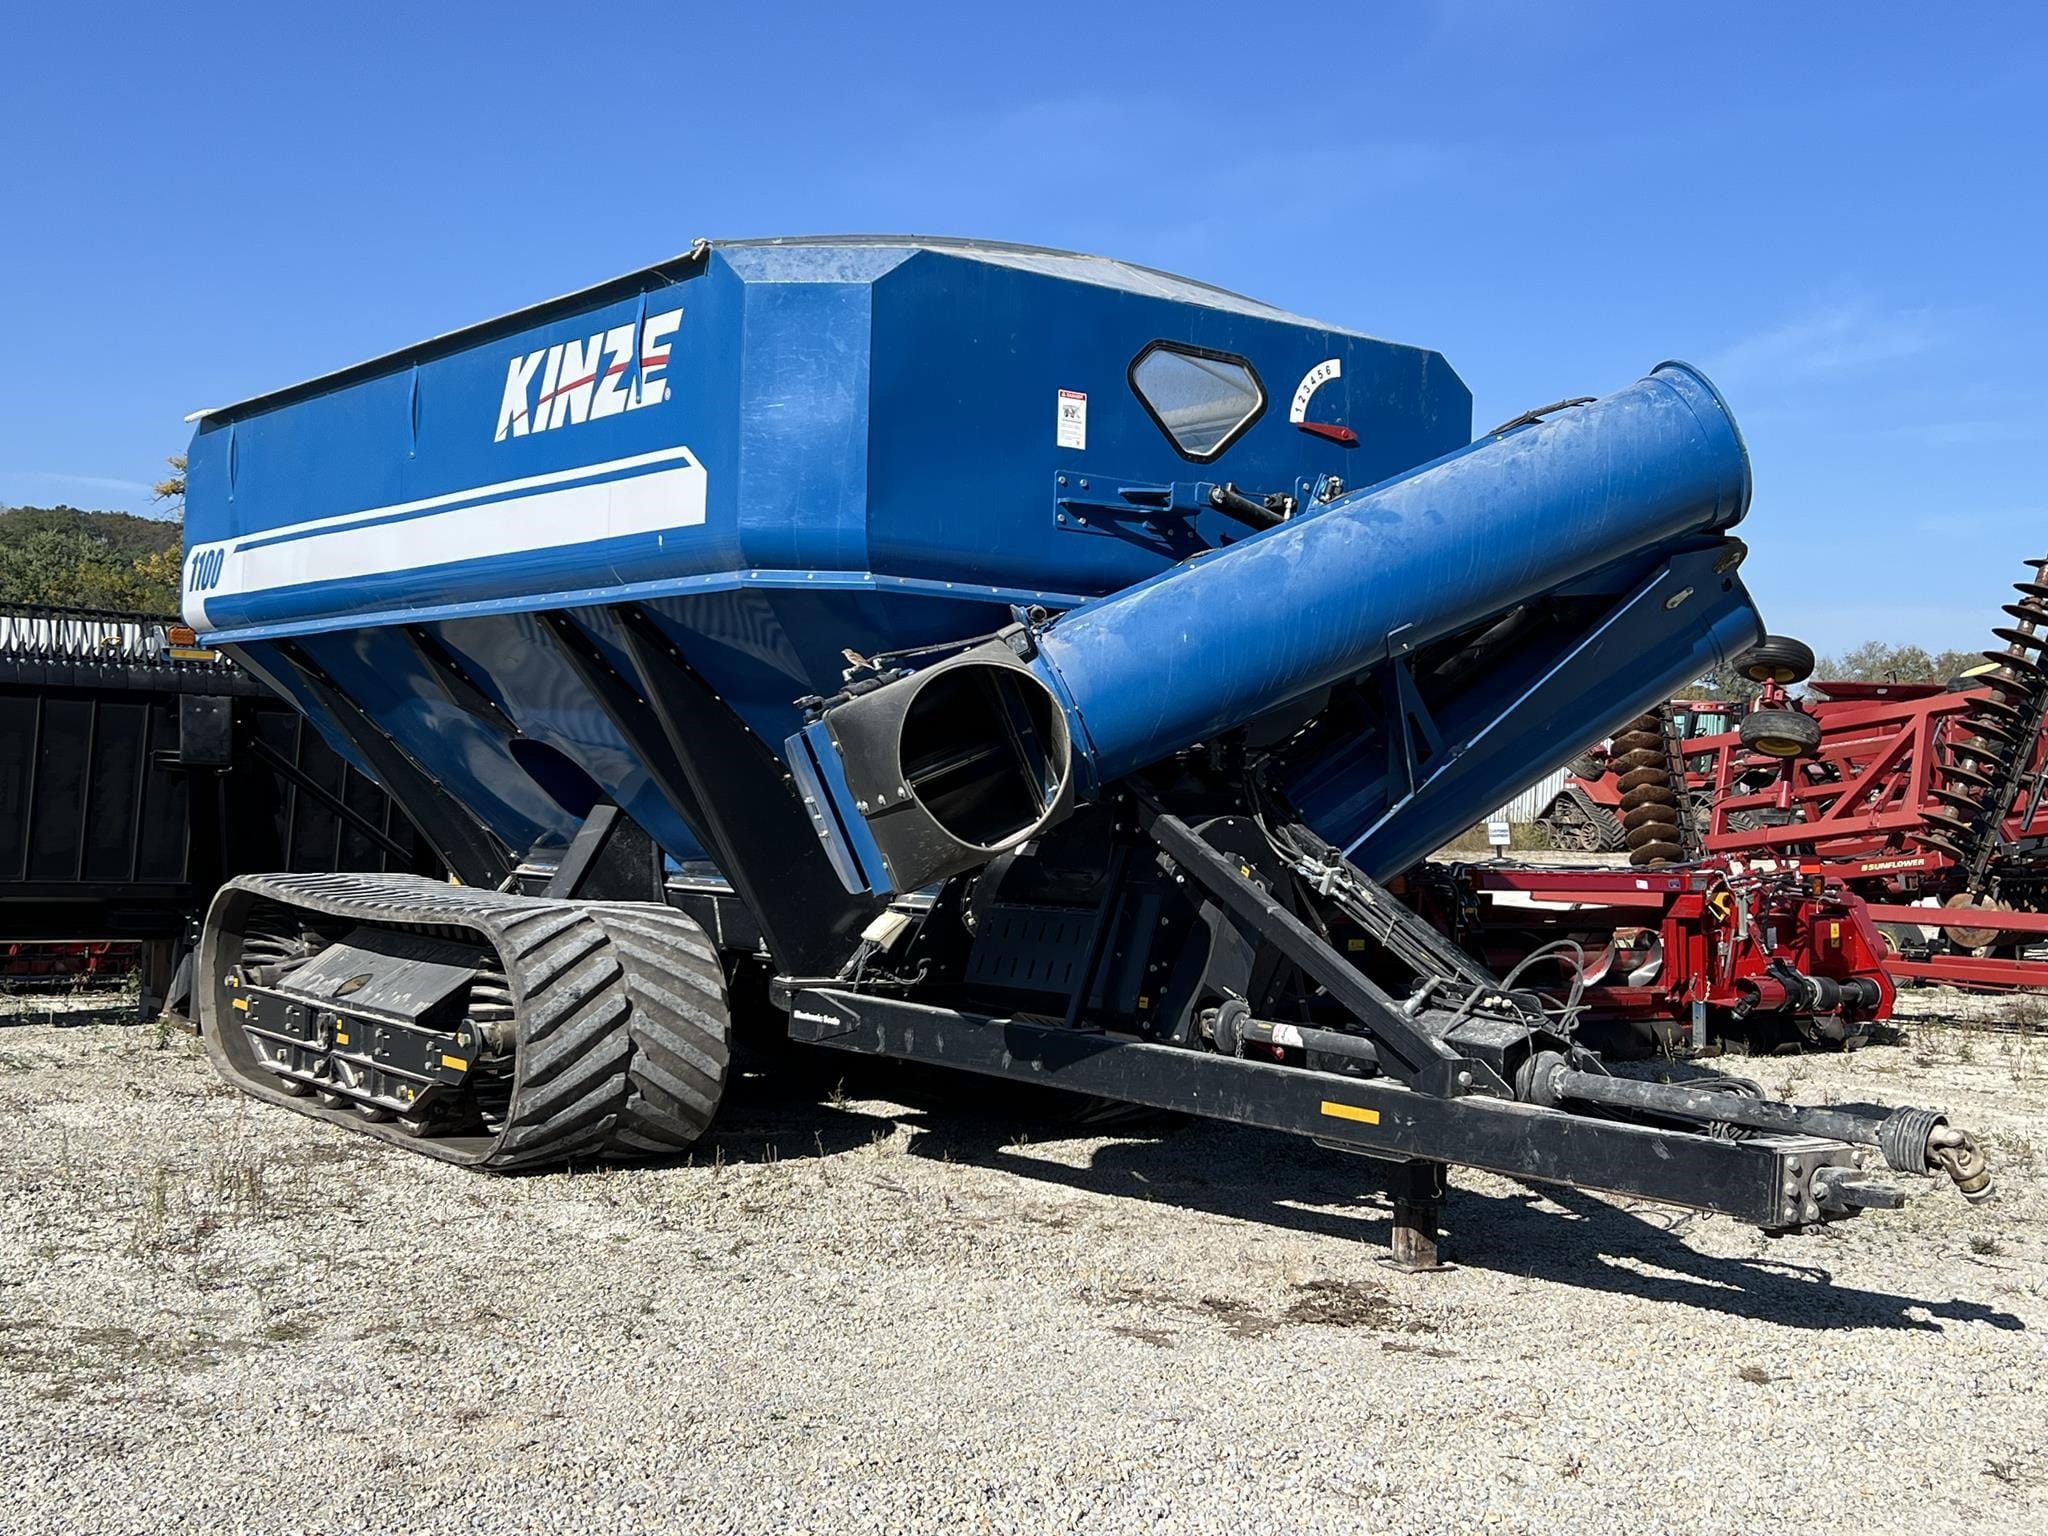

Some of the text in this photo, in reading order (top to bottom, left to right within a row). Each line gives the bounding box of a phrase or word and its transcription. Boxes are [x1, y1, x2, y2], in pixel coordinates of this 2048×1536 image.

[494, 308, 684, 443] KINZE
[1298, 395, 1306, 403] 2
[1303, 385, 1310, 393] 3
[1310, 376, 1316, 385] 4
[1317, 369, 1323, 379] 5
[1325, 365, 1331, 375] 6
[189, 548, 224, 592] 1100
[1868, 858, 1925, 870] SUNFLOWER
